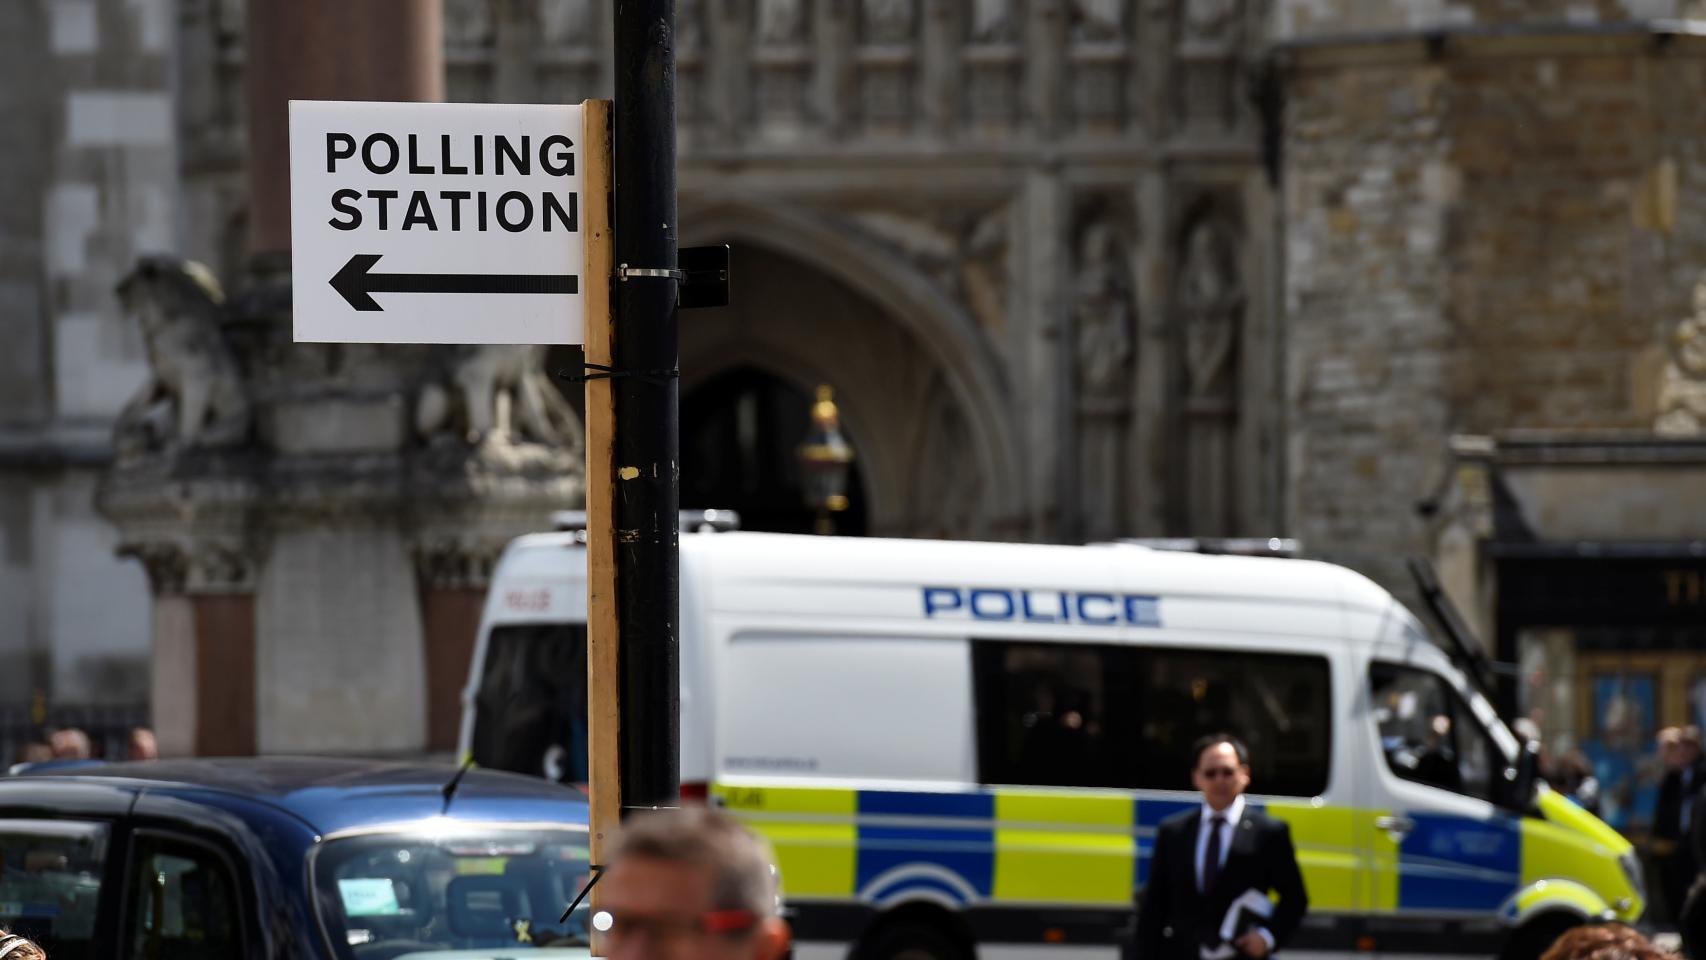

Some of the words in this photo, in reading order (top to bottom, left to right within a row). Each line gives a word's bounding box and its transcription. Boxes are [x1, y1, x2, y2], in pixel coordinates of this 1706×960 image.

[326, 132, 575, 177] POLLING
[328, 188, 579, 233] STATION
[922, 586, 1163, 628] POLICE
